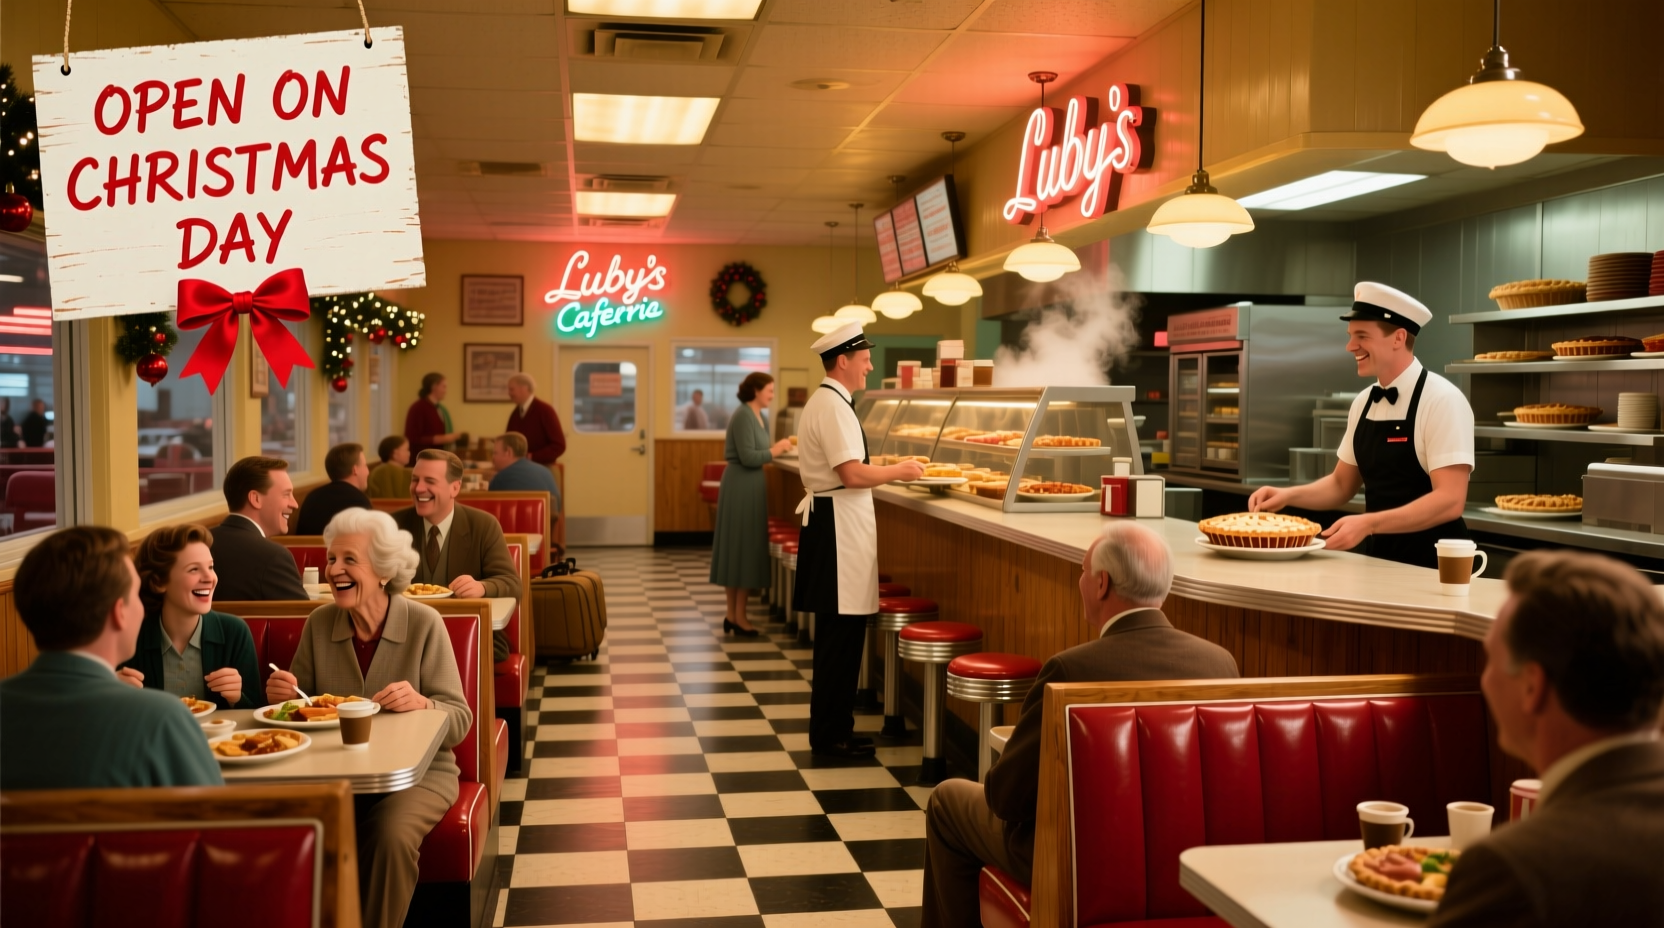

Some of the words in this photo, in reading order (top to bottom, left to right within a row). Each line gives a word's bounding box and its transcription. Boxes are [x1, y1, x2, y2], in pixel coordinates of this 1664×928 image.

[93, 73, 246, 136] OPEN
[272, 65, 351, 122] ON
[66, 133, 391, 211] CHRISTMAS
[1003, 84, 1142, 223] Luby's
[177, 208, 294, 270] DAY
[544, 250, 667, 305] Luby's
